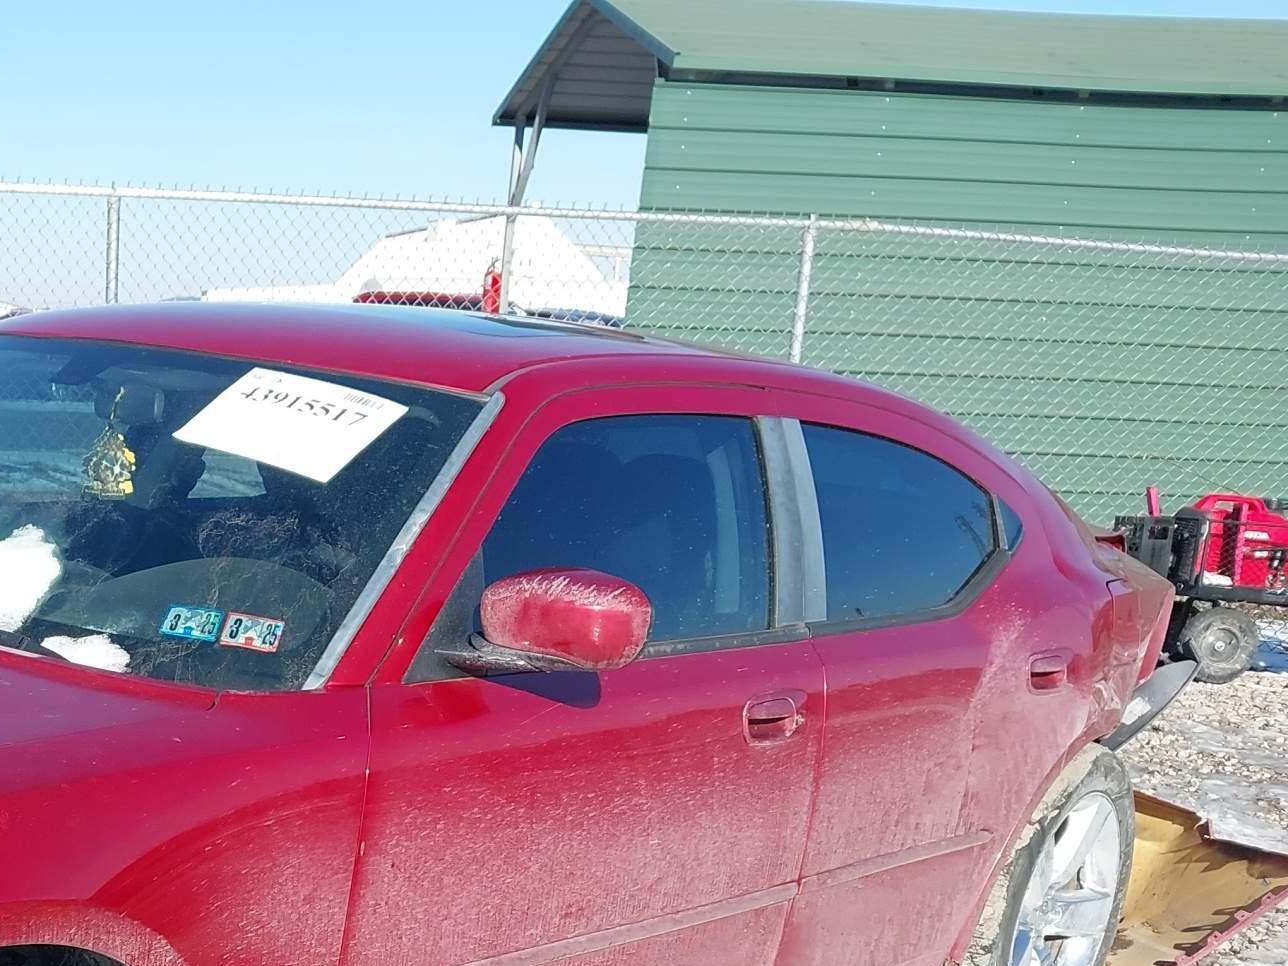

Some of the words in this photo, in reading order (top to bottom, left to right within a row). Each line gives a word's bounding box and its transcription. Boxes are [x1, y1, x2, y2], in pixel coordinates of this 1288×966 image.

[240, 386, 369, 426] 43915517
[169, 613, 182, 631] 3
[202, 613, 219, 634] 25
[229, 618, 243, 639] 3
[262, 623, 279, 645] 25
